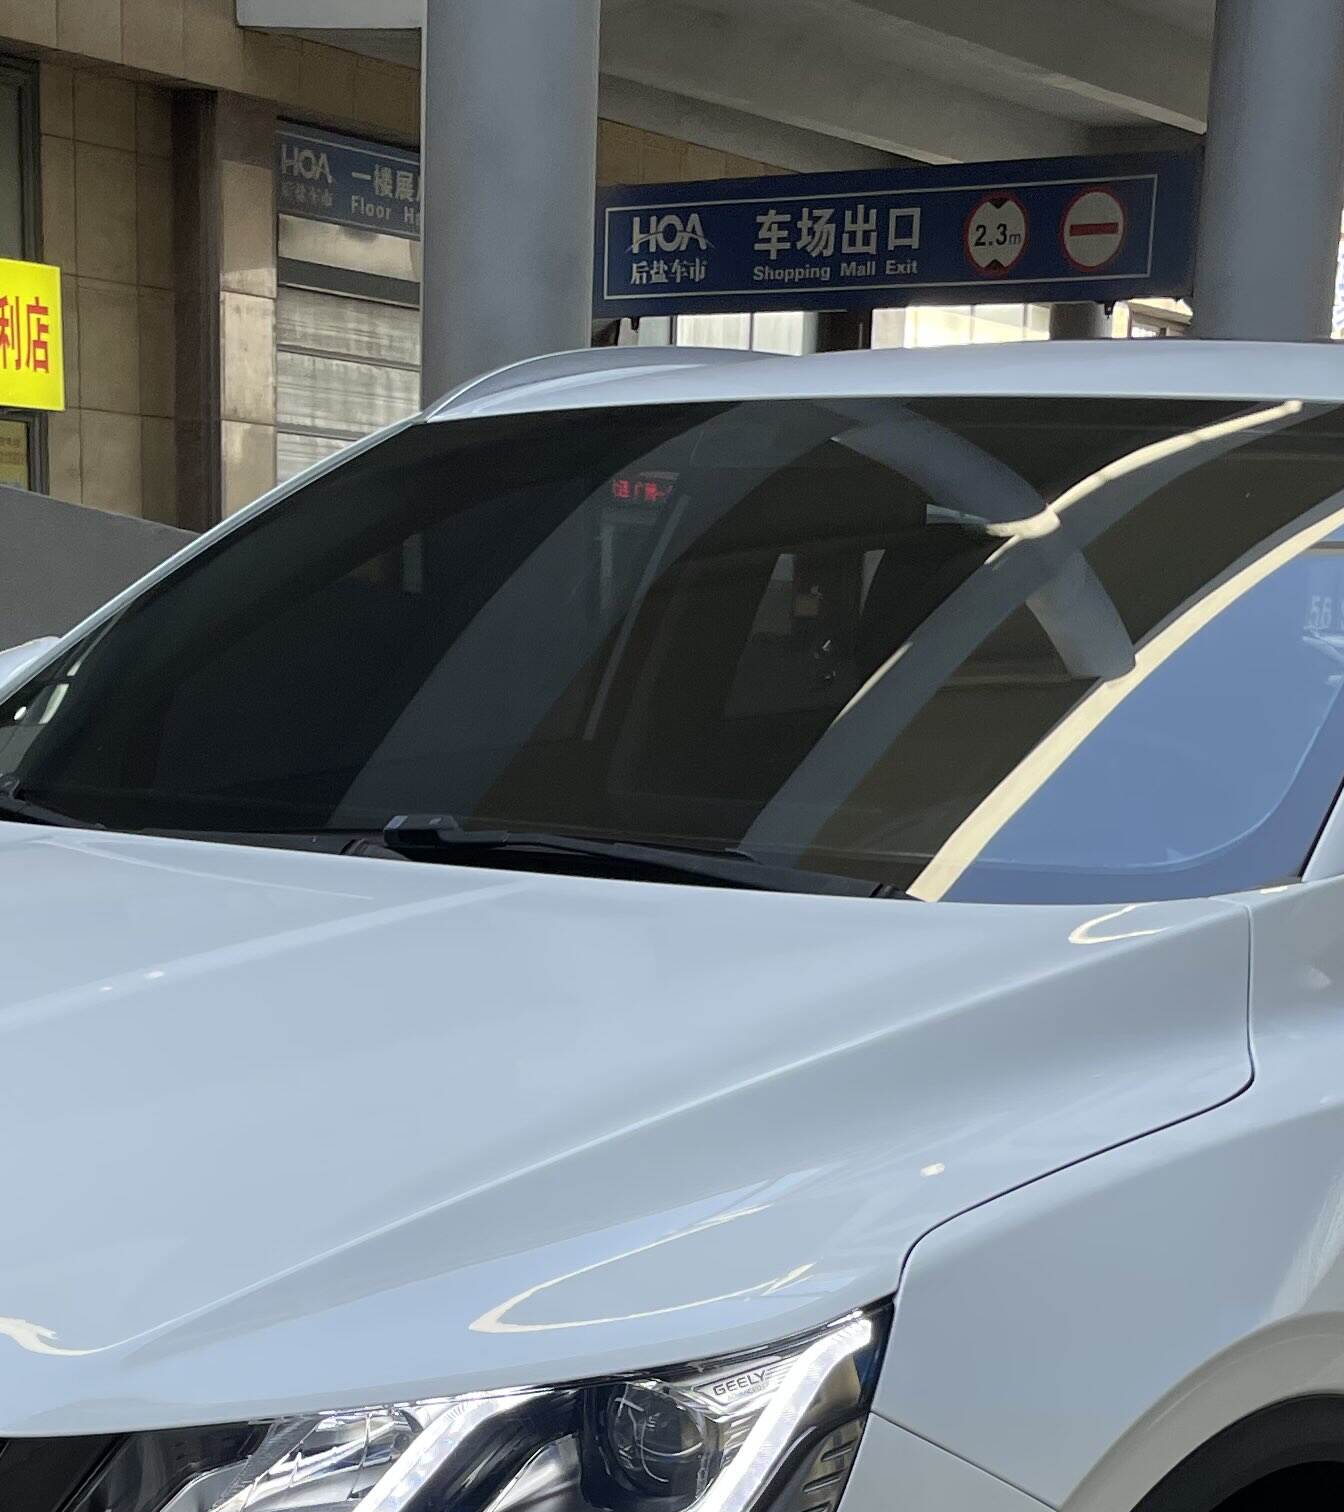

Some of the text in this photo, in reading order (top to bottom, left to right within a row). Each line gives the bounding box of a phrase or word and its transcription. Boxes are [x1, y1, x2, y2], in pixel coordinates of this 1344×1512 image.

[281, 144, 333, 184] HOA
[352, 165, 421, 202] 一楼展
[351, 195, 392, 220] Floor
[632, 213, 707, 253] HOA
[753, 204, 921, 260] 车场出口
[753, 259, 918, 282] Shopping Mall Exit
[713, 1370, 765, 1396] GEELY
